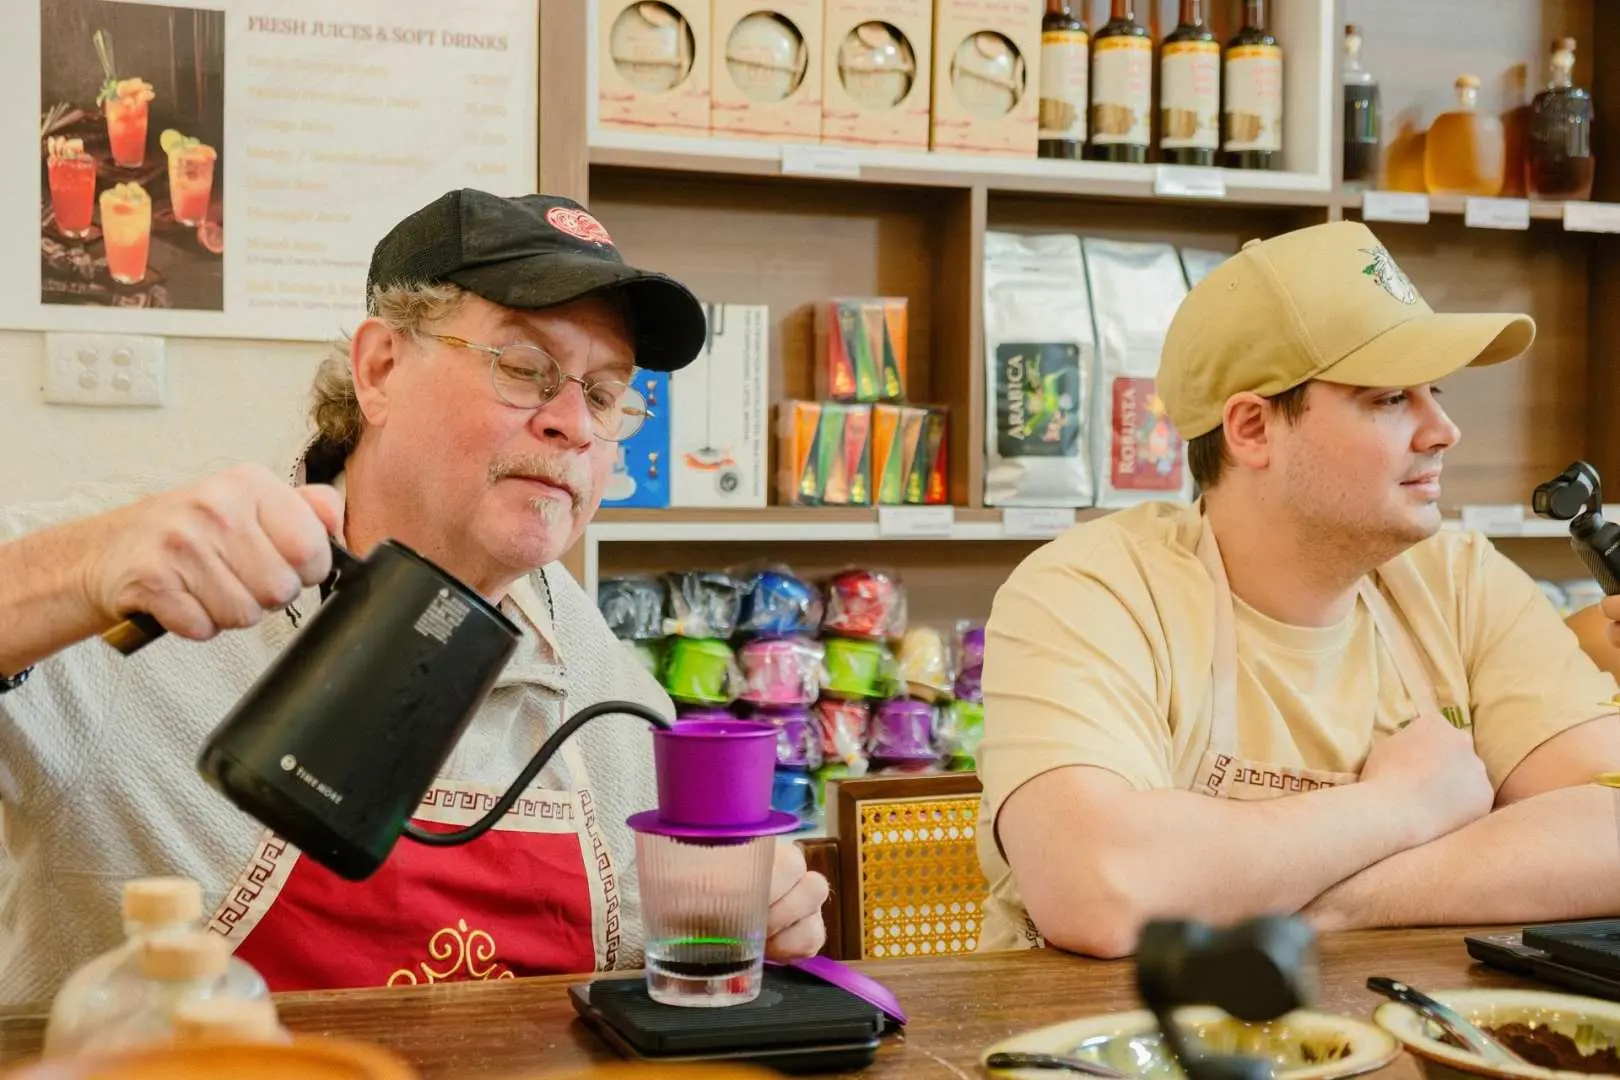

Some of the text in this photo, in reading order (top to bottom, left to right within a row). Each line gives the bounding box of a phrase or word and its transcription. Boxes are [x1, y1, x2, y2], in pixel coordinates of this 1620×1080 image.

[248, 15, 508, 51] FRESH JUICES & SOFT DRINKS
[1007, 355, 1025, 440] ARABICA
